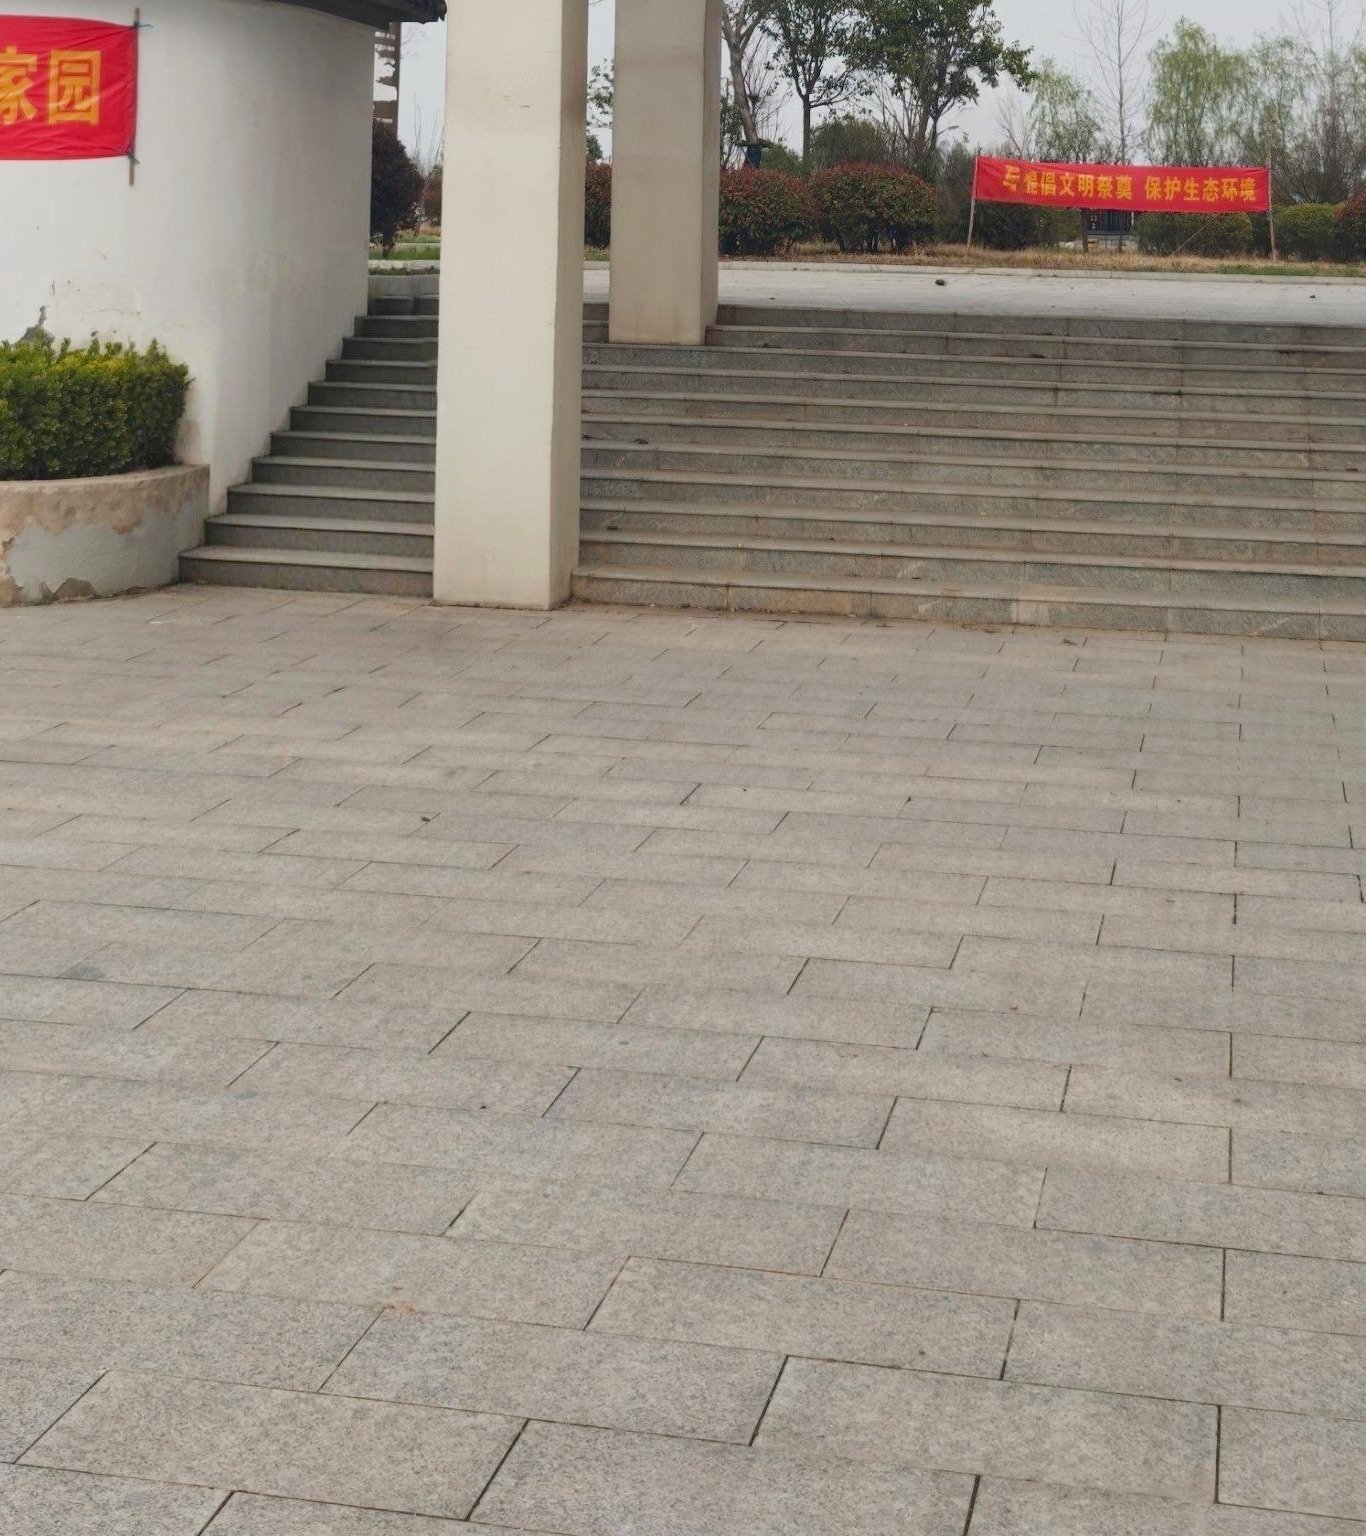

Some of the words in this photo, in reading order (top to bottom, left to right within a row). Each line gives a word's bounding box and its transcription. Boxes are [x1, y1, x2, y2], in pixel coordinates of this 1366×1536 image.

[1144, 175, 1257, 203] 保护生态环境
